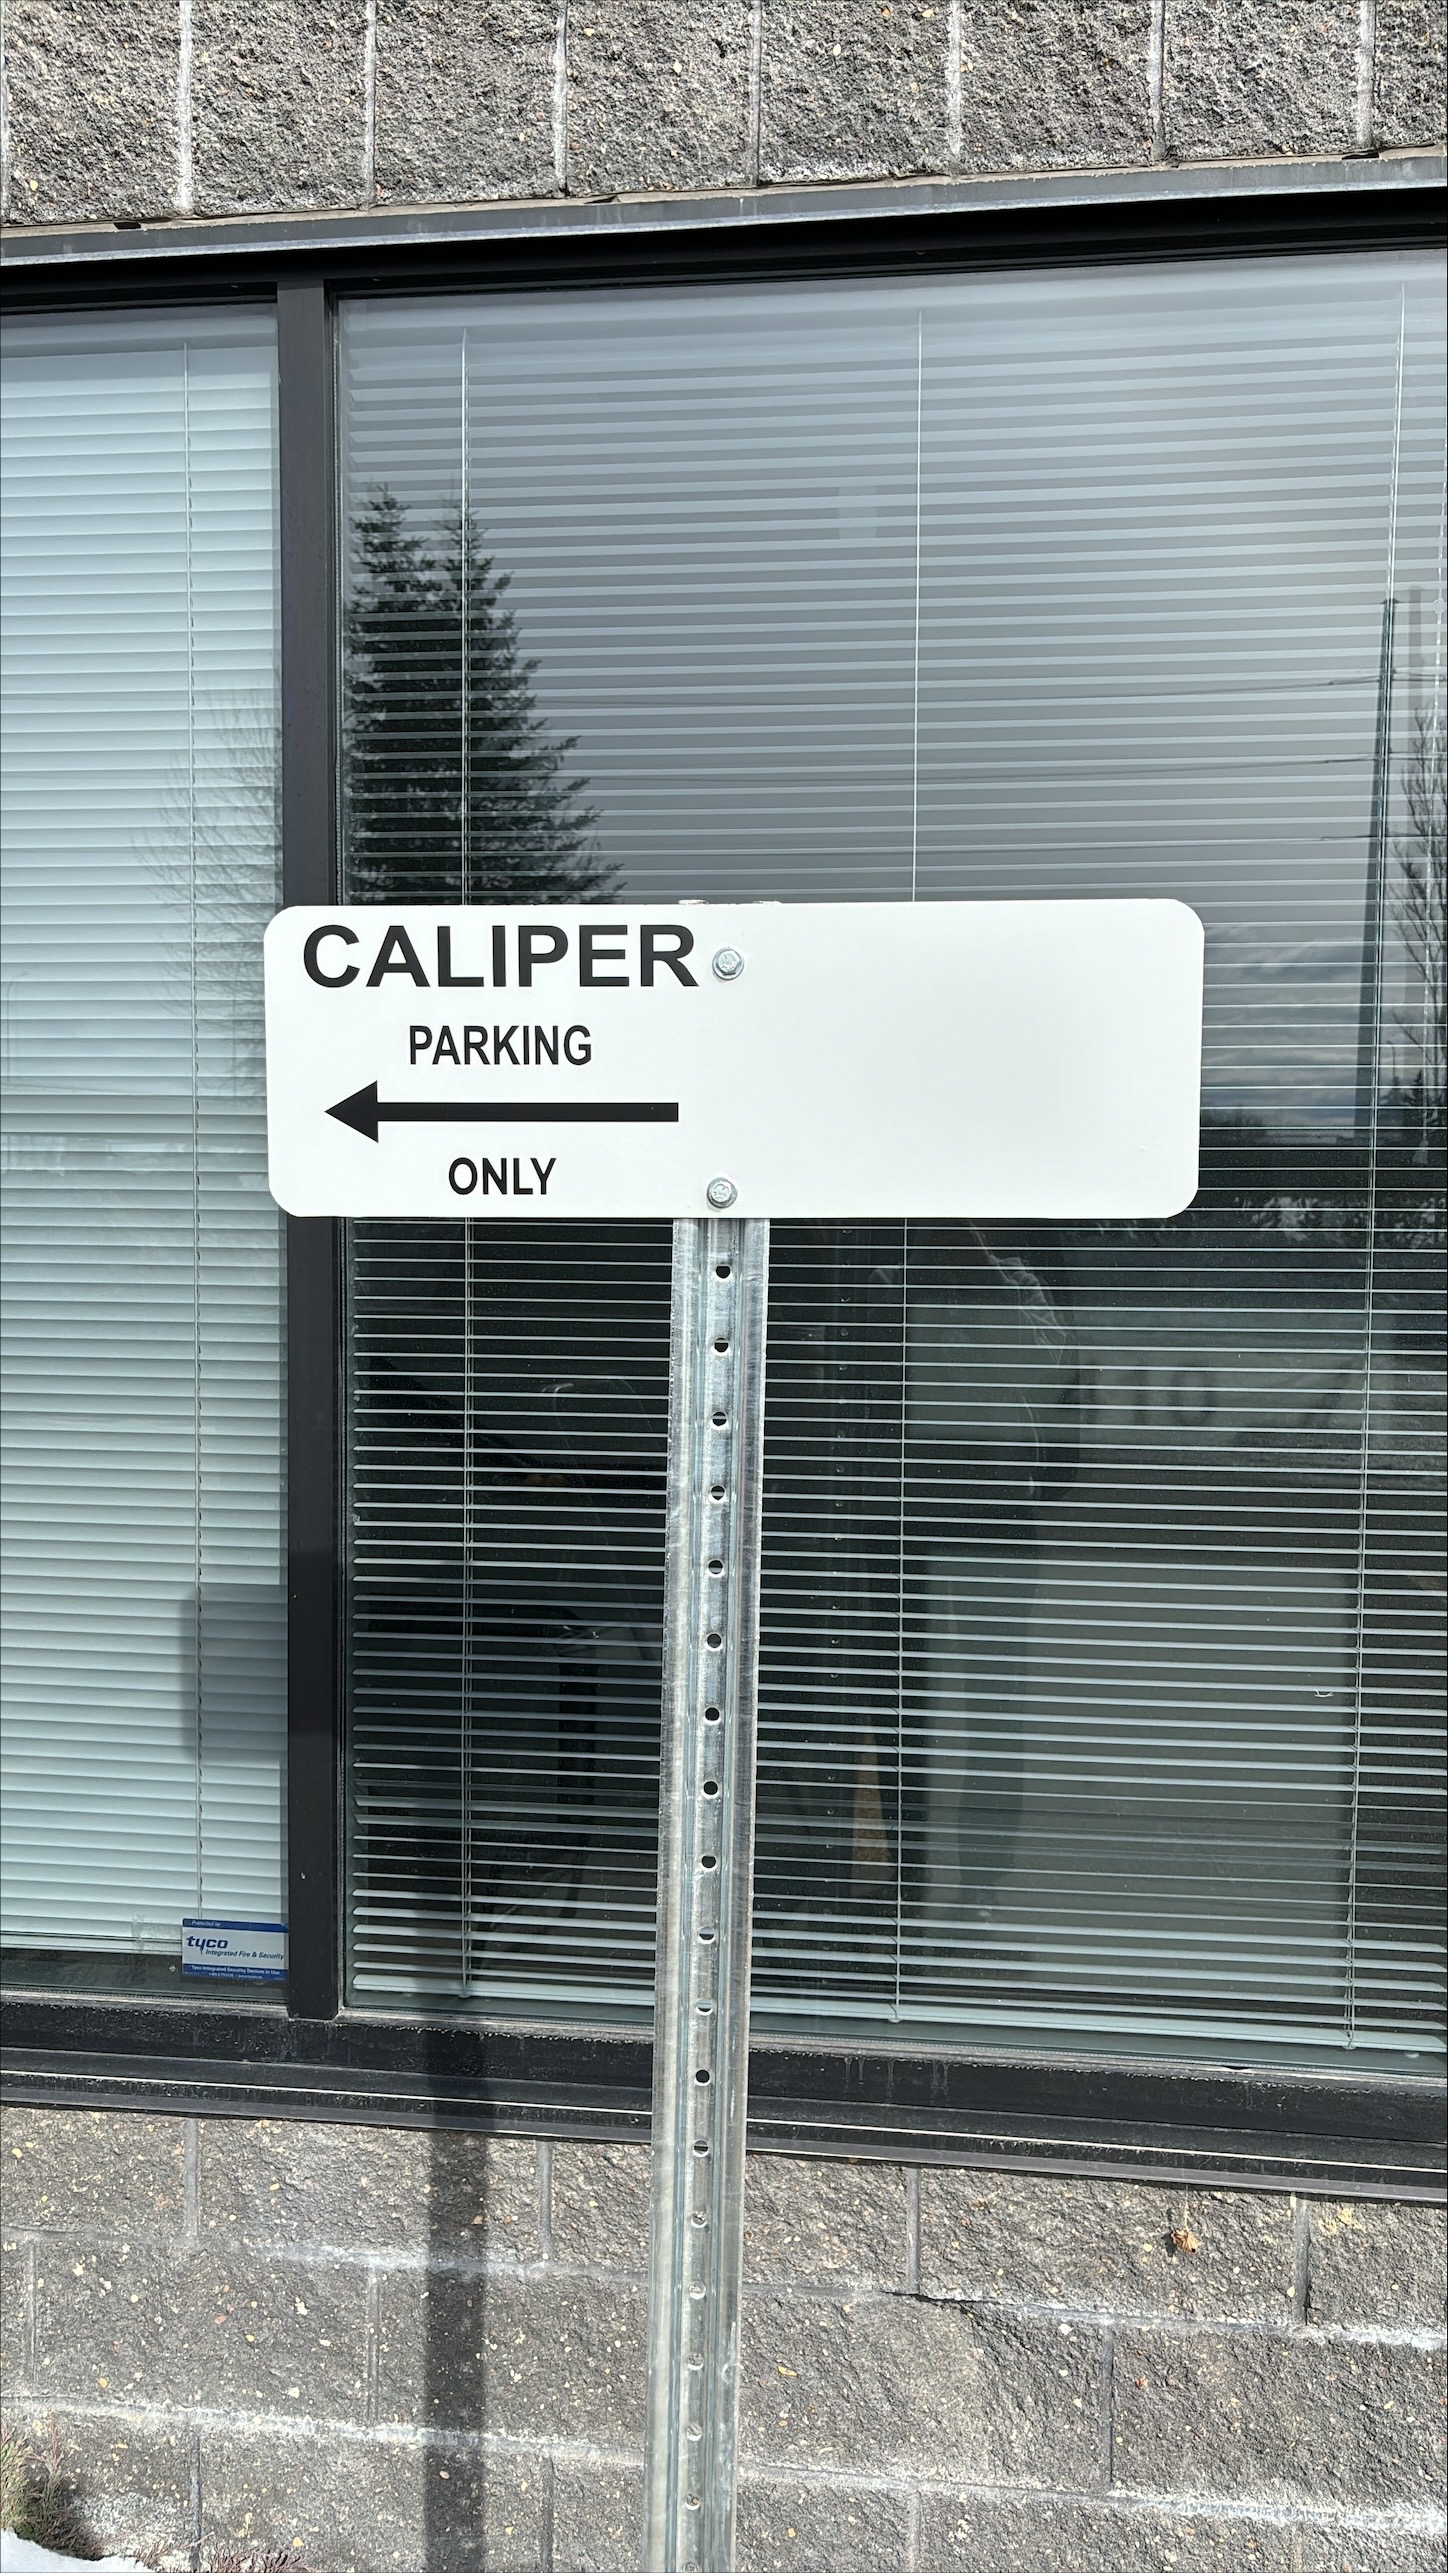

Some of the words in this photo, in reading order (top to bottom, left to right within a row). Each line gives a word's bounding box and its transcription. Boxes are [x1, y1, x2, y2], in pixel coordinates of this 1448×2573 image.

[303, 924, 699, 988] CALIPER
[409, 1024, 592, 1066] PARKING
[448, 1157, 557, 1196] ONLY
[186, 1935, 229, 1955] tyco
[205, 1949, 238, 1958] Integrated
[258, 1952, 285, 1960] Security
